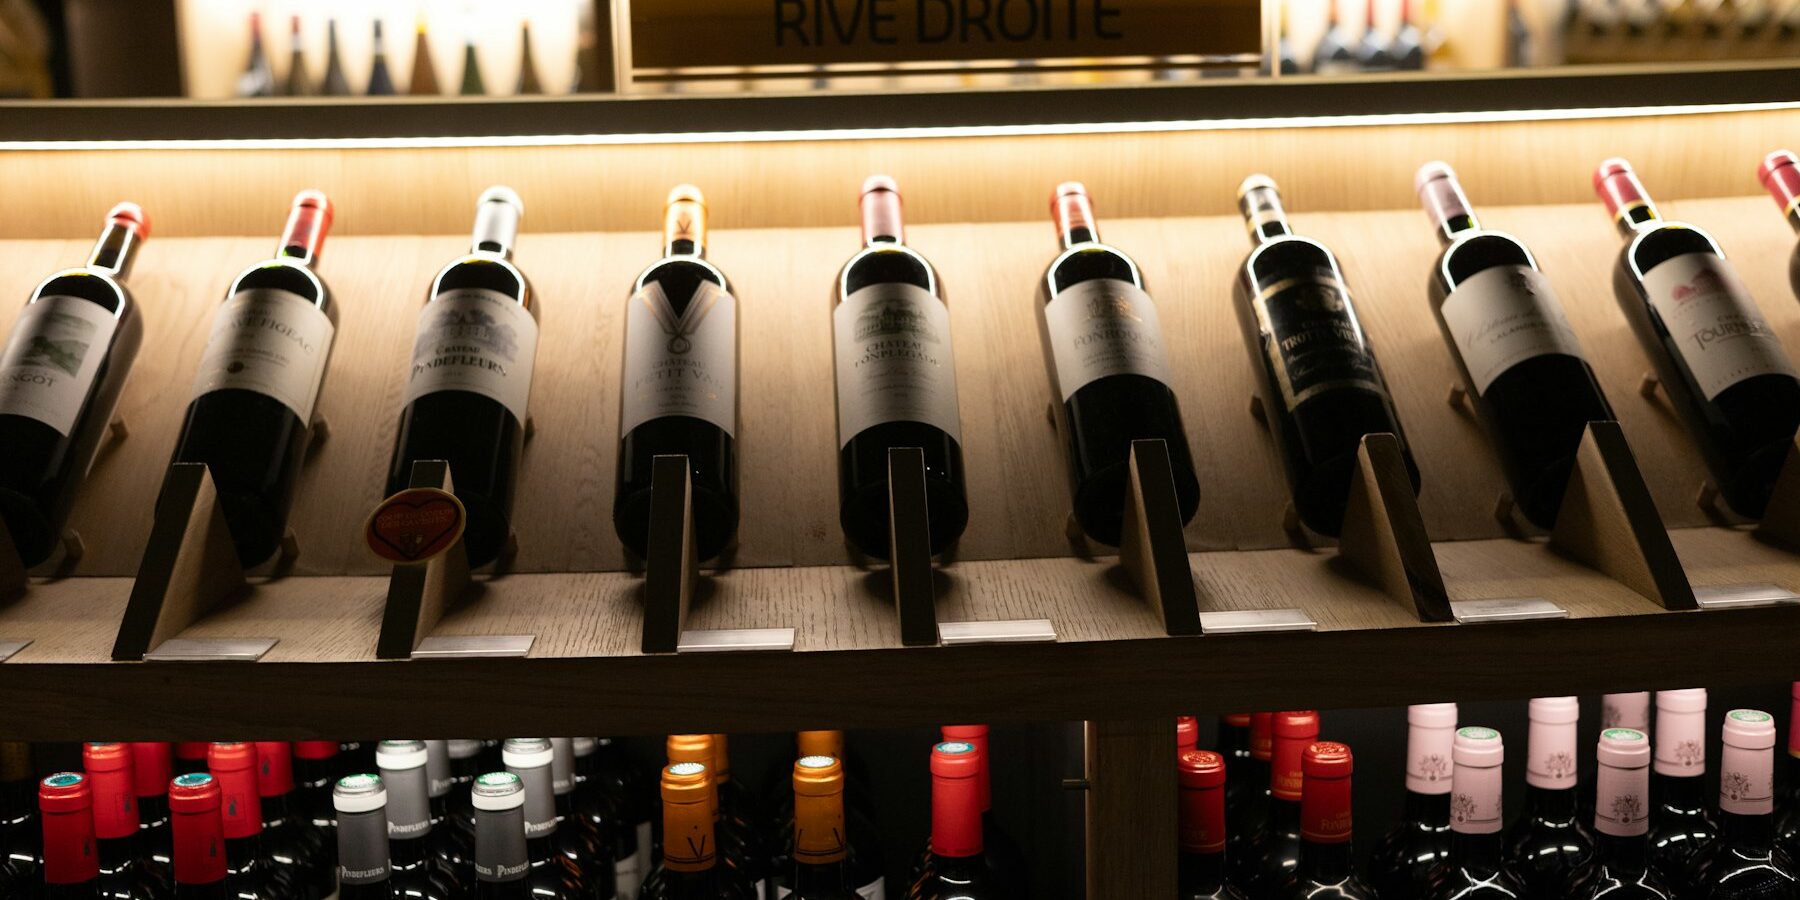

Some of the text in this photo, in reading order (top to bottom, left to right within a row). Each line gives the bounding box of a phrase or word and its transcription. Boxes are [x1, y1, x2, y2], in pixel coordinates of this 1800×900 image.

[774, 0, 1123, 47] RIVE DROITE
[341, 865, 385, 879] PINDEFLEURS
